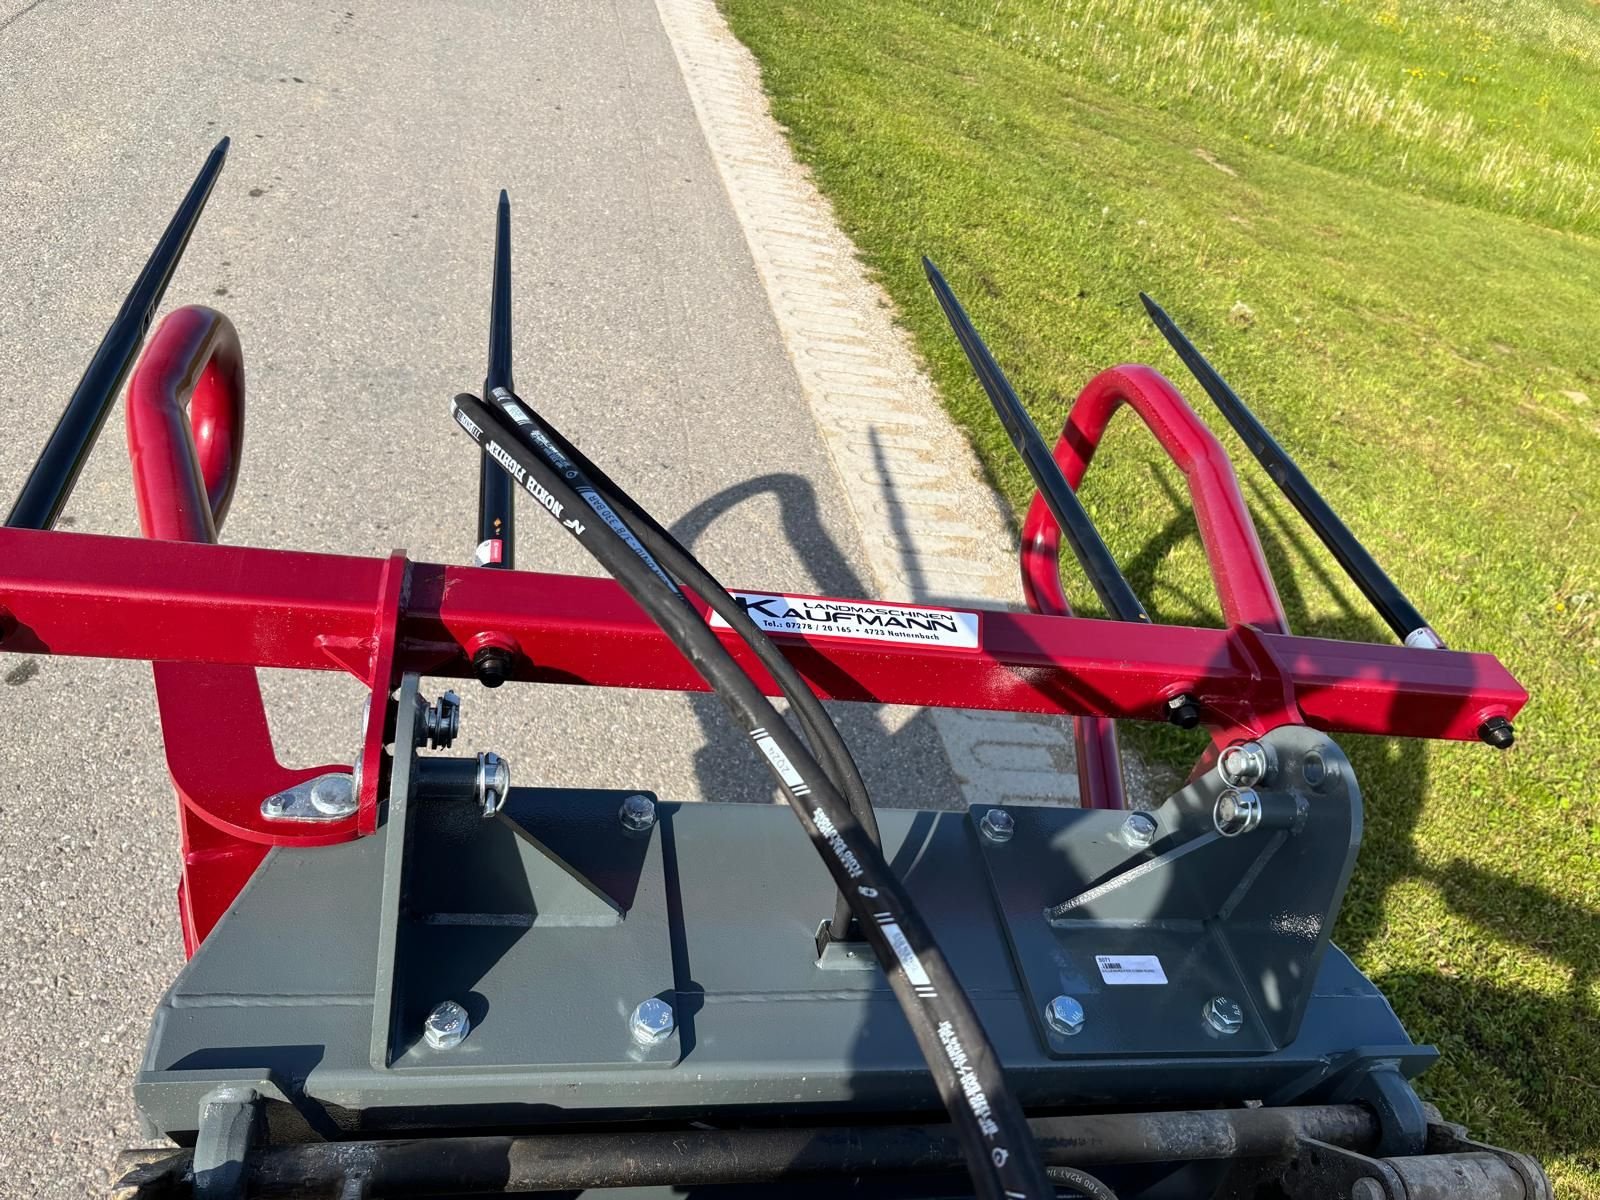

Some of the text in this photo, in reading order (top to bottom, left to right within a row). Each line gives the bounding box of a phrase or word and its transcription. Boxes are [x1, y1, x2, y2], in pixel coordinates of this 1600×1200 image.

[525, 476, 564, 518] NORTH
[589, 494, 604, 512] BAR
[601, 508, 618, 526] 330
[735, 597, 958, 633] KAUFMANN
[803, 602, 954, 621] LANDMASCHINEN
[763, 620, 783, 628] Tel.:
[785, 622, 813, 630] 07278
[822, 624, 833, 632] 20
[836, 625, 852, 633] 165
[864, 628, 885, 636] 4723
[887, 630, 940, 640] Natternbach
